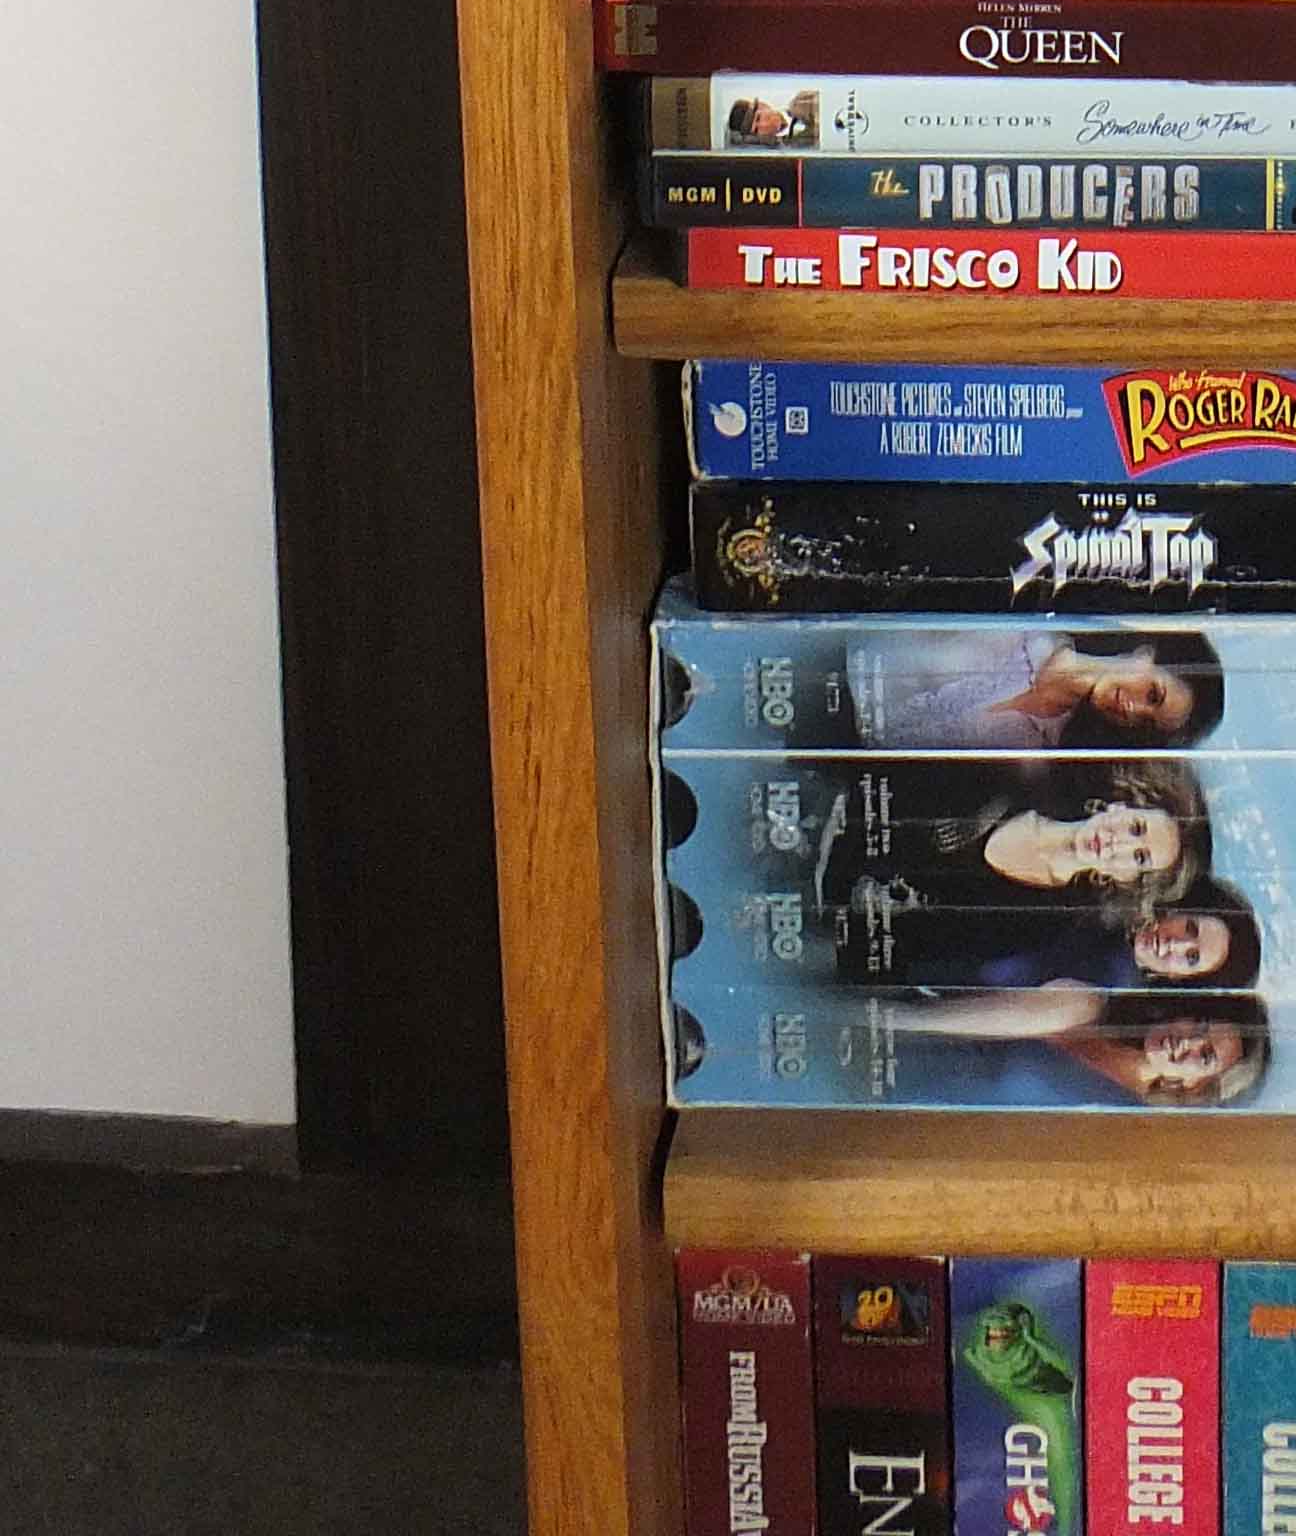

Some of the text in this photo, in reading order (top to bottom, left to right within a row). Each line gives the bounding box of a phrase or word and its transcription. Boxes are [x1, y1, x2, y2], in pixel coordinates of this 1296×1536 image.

[977, 1, 1062, 14] HELEN MIRREN
[1001, 16, 1033, 29] THE
[959, 25, 1125, 70] QUEEN
[903, 114, 1053, 128] COLLECTOR'S
[1077, 100, 1196, 145] Somewhere
[668, 185, 783, 204] MGM DVD
[918, 163, 1200, 227] PRODUCERS
[738, 234, 1123, 291] THE FRISCO KID
[750, 362, 765, 470] TOUCHSTONE
[765, 373, 779, 462] HOME VIDEO
[830, 382, 1065, 419] TOUCHSTONE PICTURES STEVEN SPIELBERG
[1126, 378, 1246, 463] ROGER
[881, 422, 1023, 456] A ROBERT ZEMECKIS FILM
[1078, 493, 1157, 506] THIS IS
[1118, 507, 1217, 599] Tap
[761, 657, 794, 725] HBO
[768, 781, 799, 850] HBO
[768, 893, 802, 960] HBO
[775, 1014, 807, 1078] HBO
[694, 1291, 796, 1313] MGM/UA
[727, 1351, 769, 1533] FROM RUSSIA
[1126, 1376, 1184, 1526] COLLEGE
